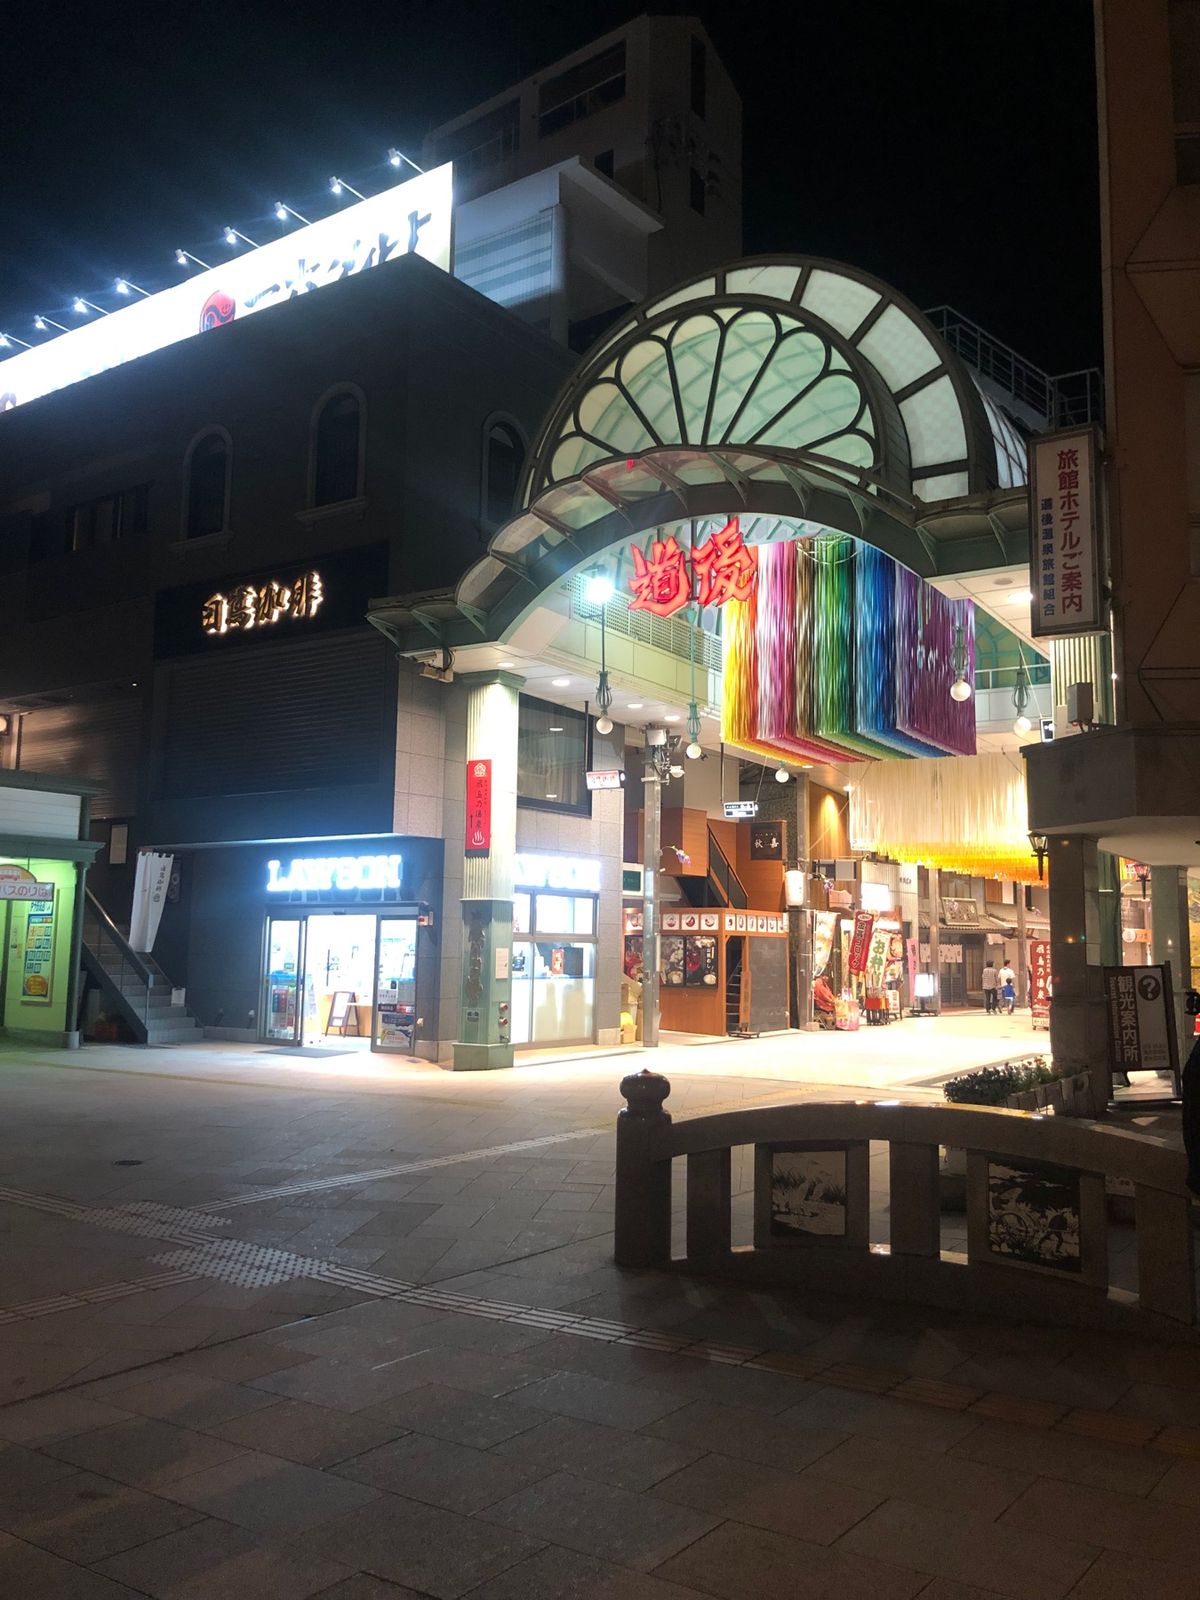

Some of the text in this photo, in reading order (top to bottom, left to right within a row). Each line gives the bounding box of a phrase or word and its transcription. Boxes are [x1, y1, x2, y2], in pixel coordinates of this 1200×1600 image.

[628, 515, 755, 618] 道後
[1057, 448, 1084, 615] 旅館ホテルご案内
[266, 854, 402, 892] LAWSON
[1117, 975, 1139, 1063] 観光案内所
